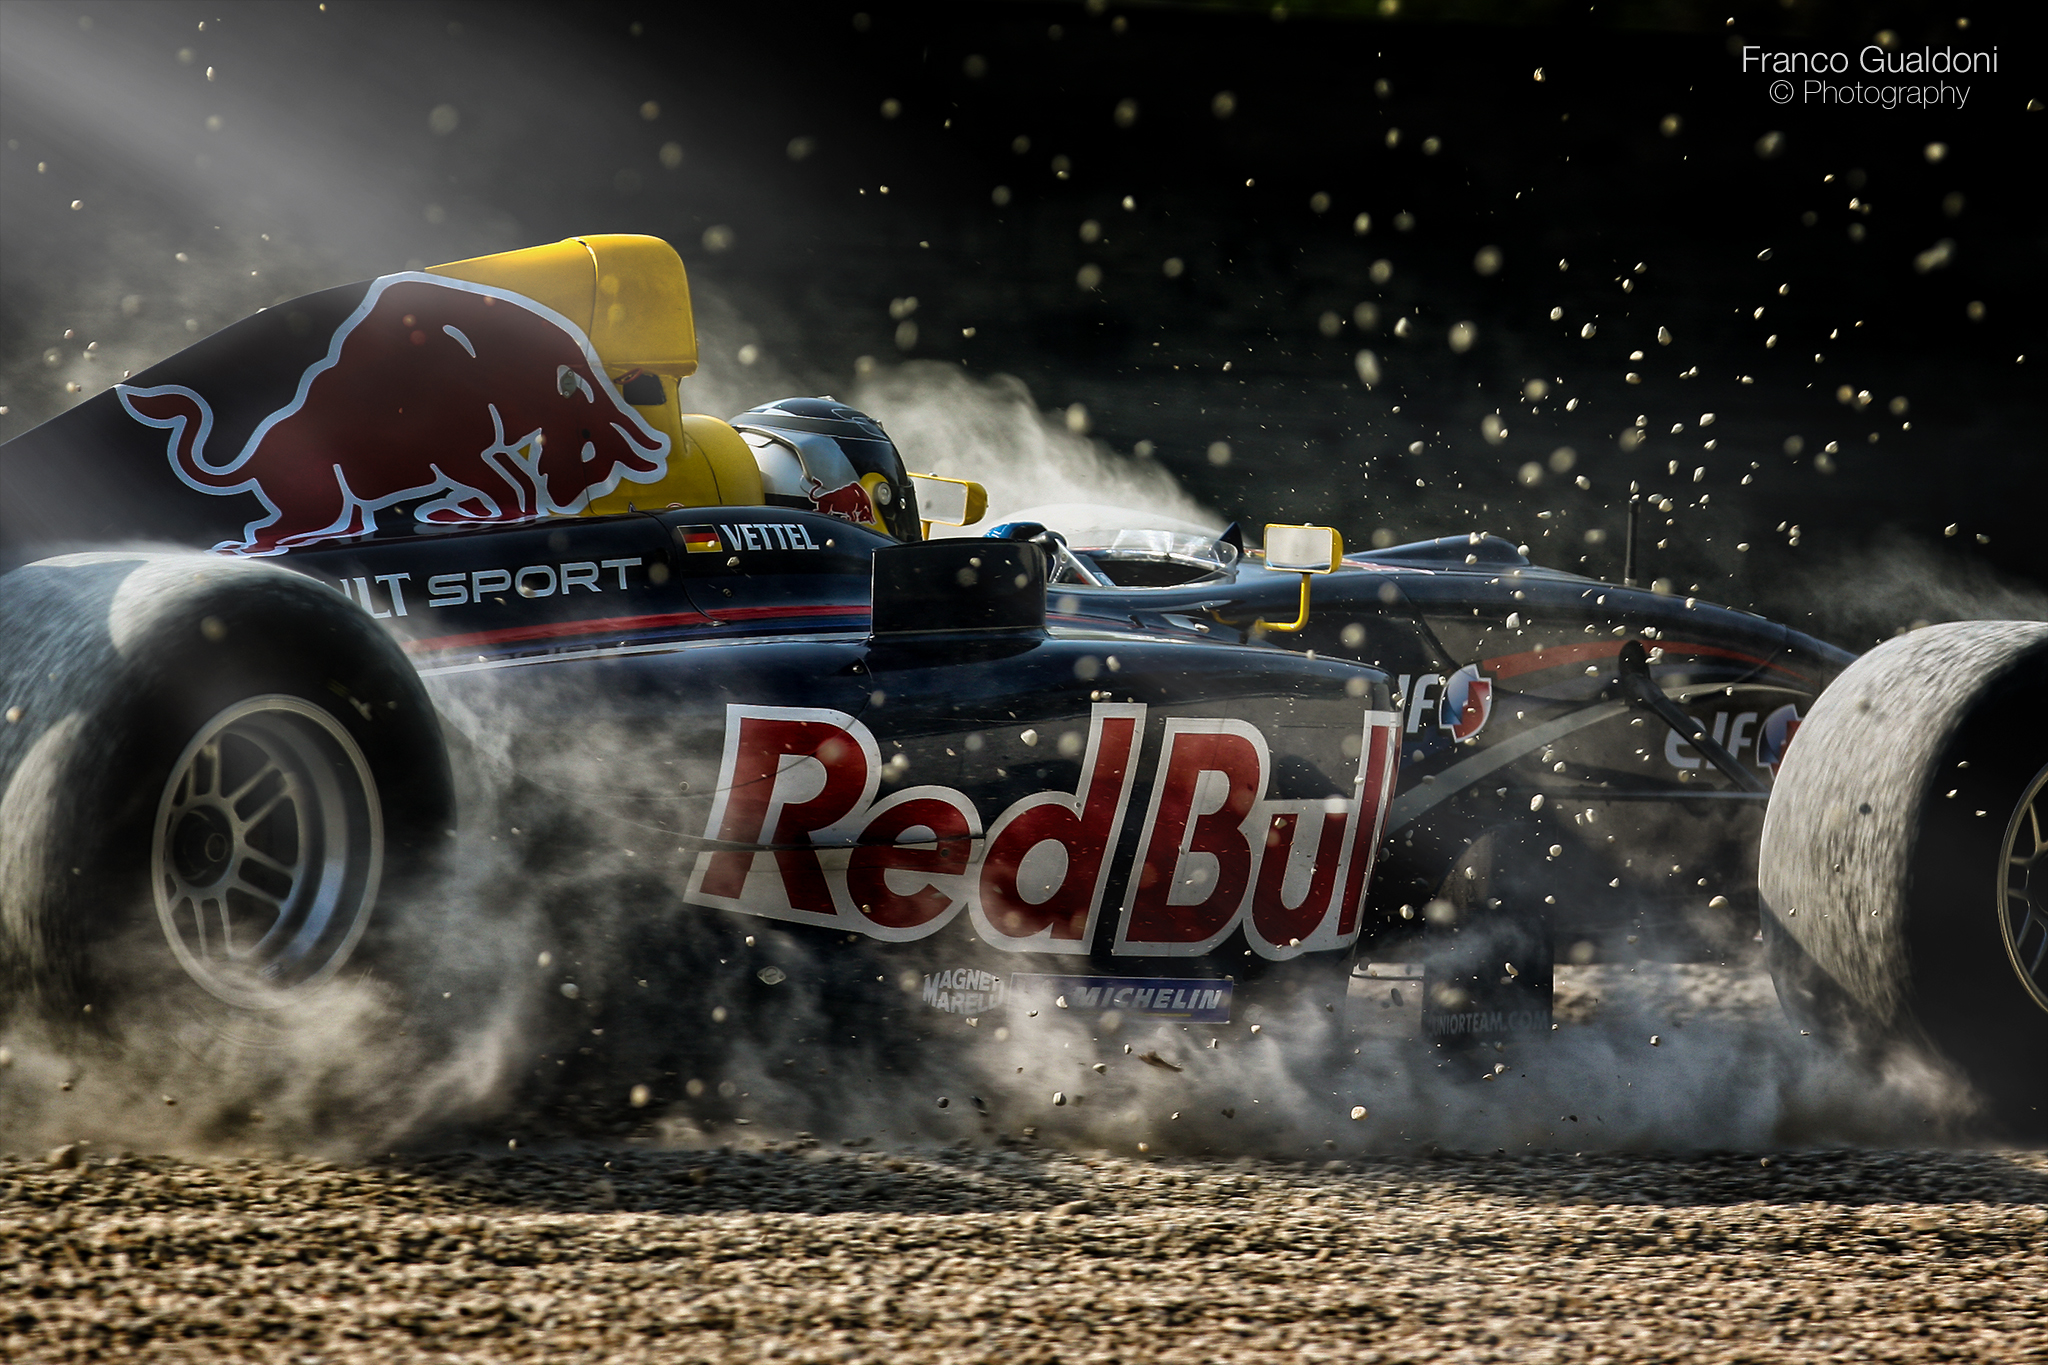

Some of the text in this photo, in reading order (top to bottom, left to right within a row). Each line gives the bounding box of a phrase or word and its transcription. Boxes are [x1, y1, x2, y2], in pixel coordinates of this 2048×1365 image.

[720, 523, 820, 551] VETTEL
[427, 557, 642, 608] SPORT
[1664, 711, 1758, 769] elf
[1073, 985, 1223, 1010] MICHELIN
